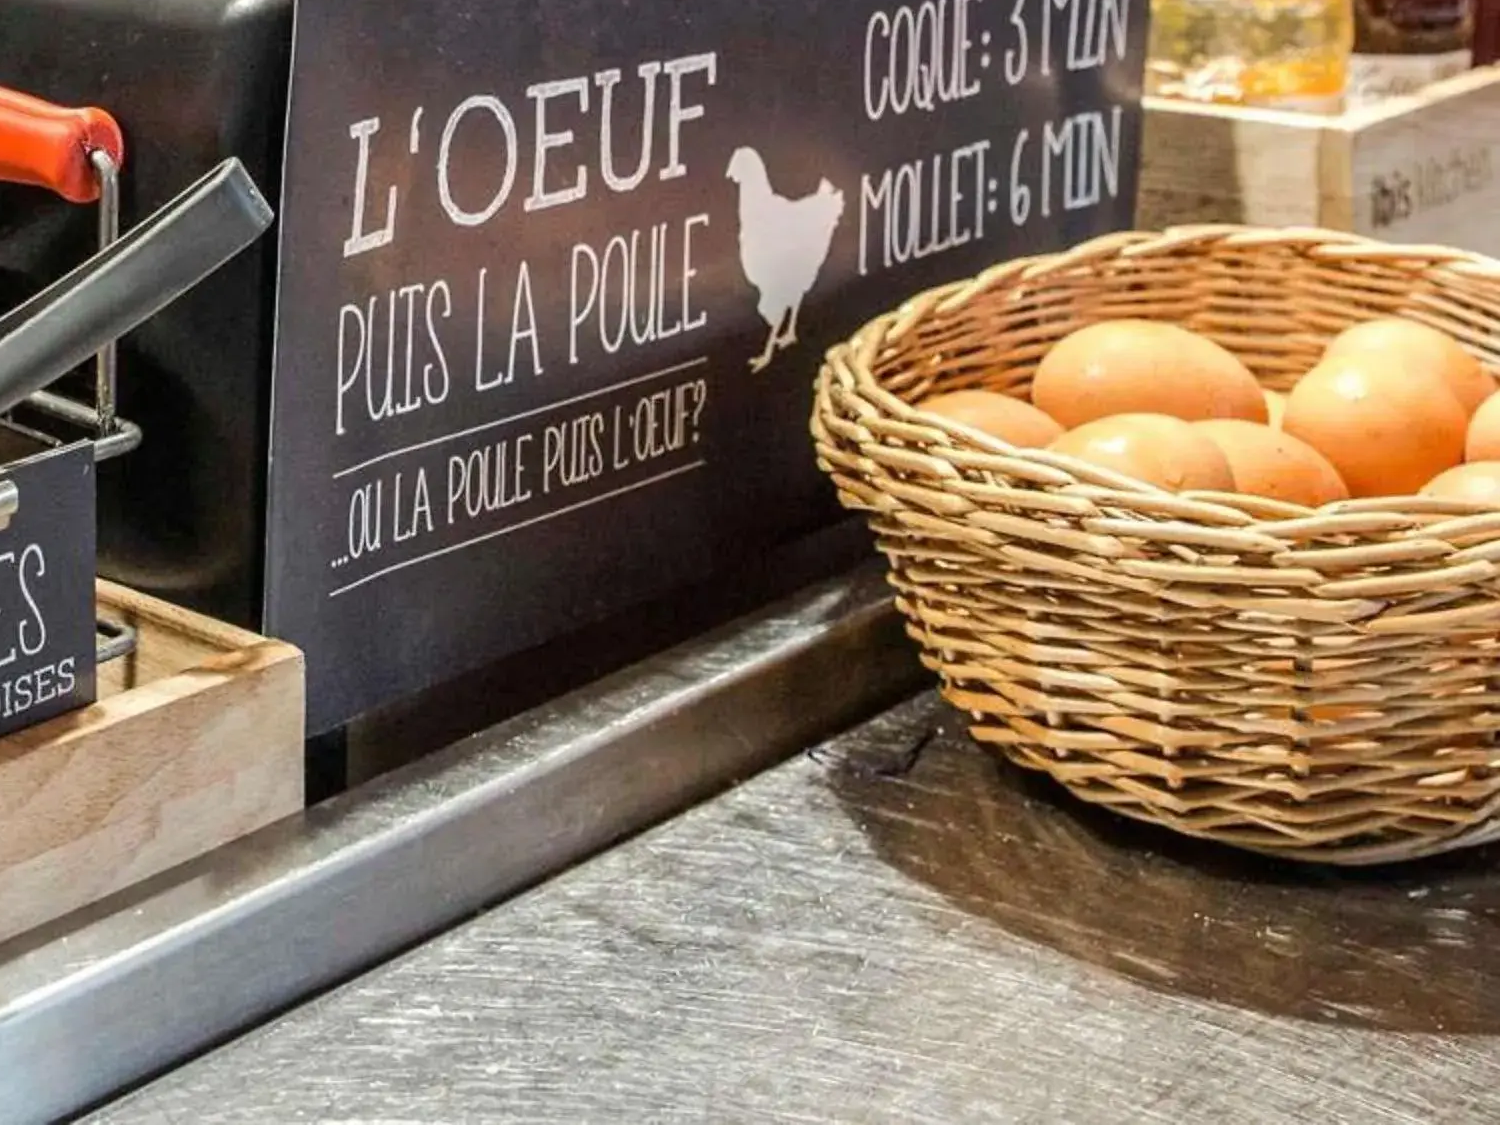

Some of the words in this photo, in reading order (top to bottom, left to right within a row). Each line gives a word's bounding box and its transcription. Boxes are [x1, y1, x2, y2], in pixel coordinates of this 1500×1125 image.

[858, 139, 998, 275] MOLLET:
[1009, 131, 1030, 227] 6
[1040, 106, 1123, 218] MIN
[335, 278, 452, 436] PUIS
[474, 260, 543, 393] LA
[569, 214, 709, 364] POULE
[393, 467, 435, 543] LA
[447, 433, 534, 525] POULE
[543, 412, 605, 494] PUIS
